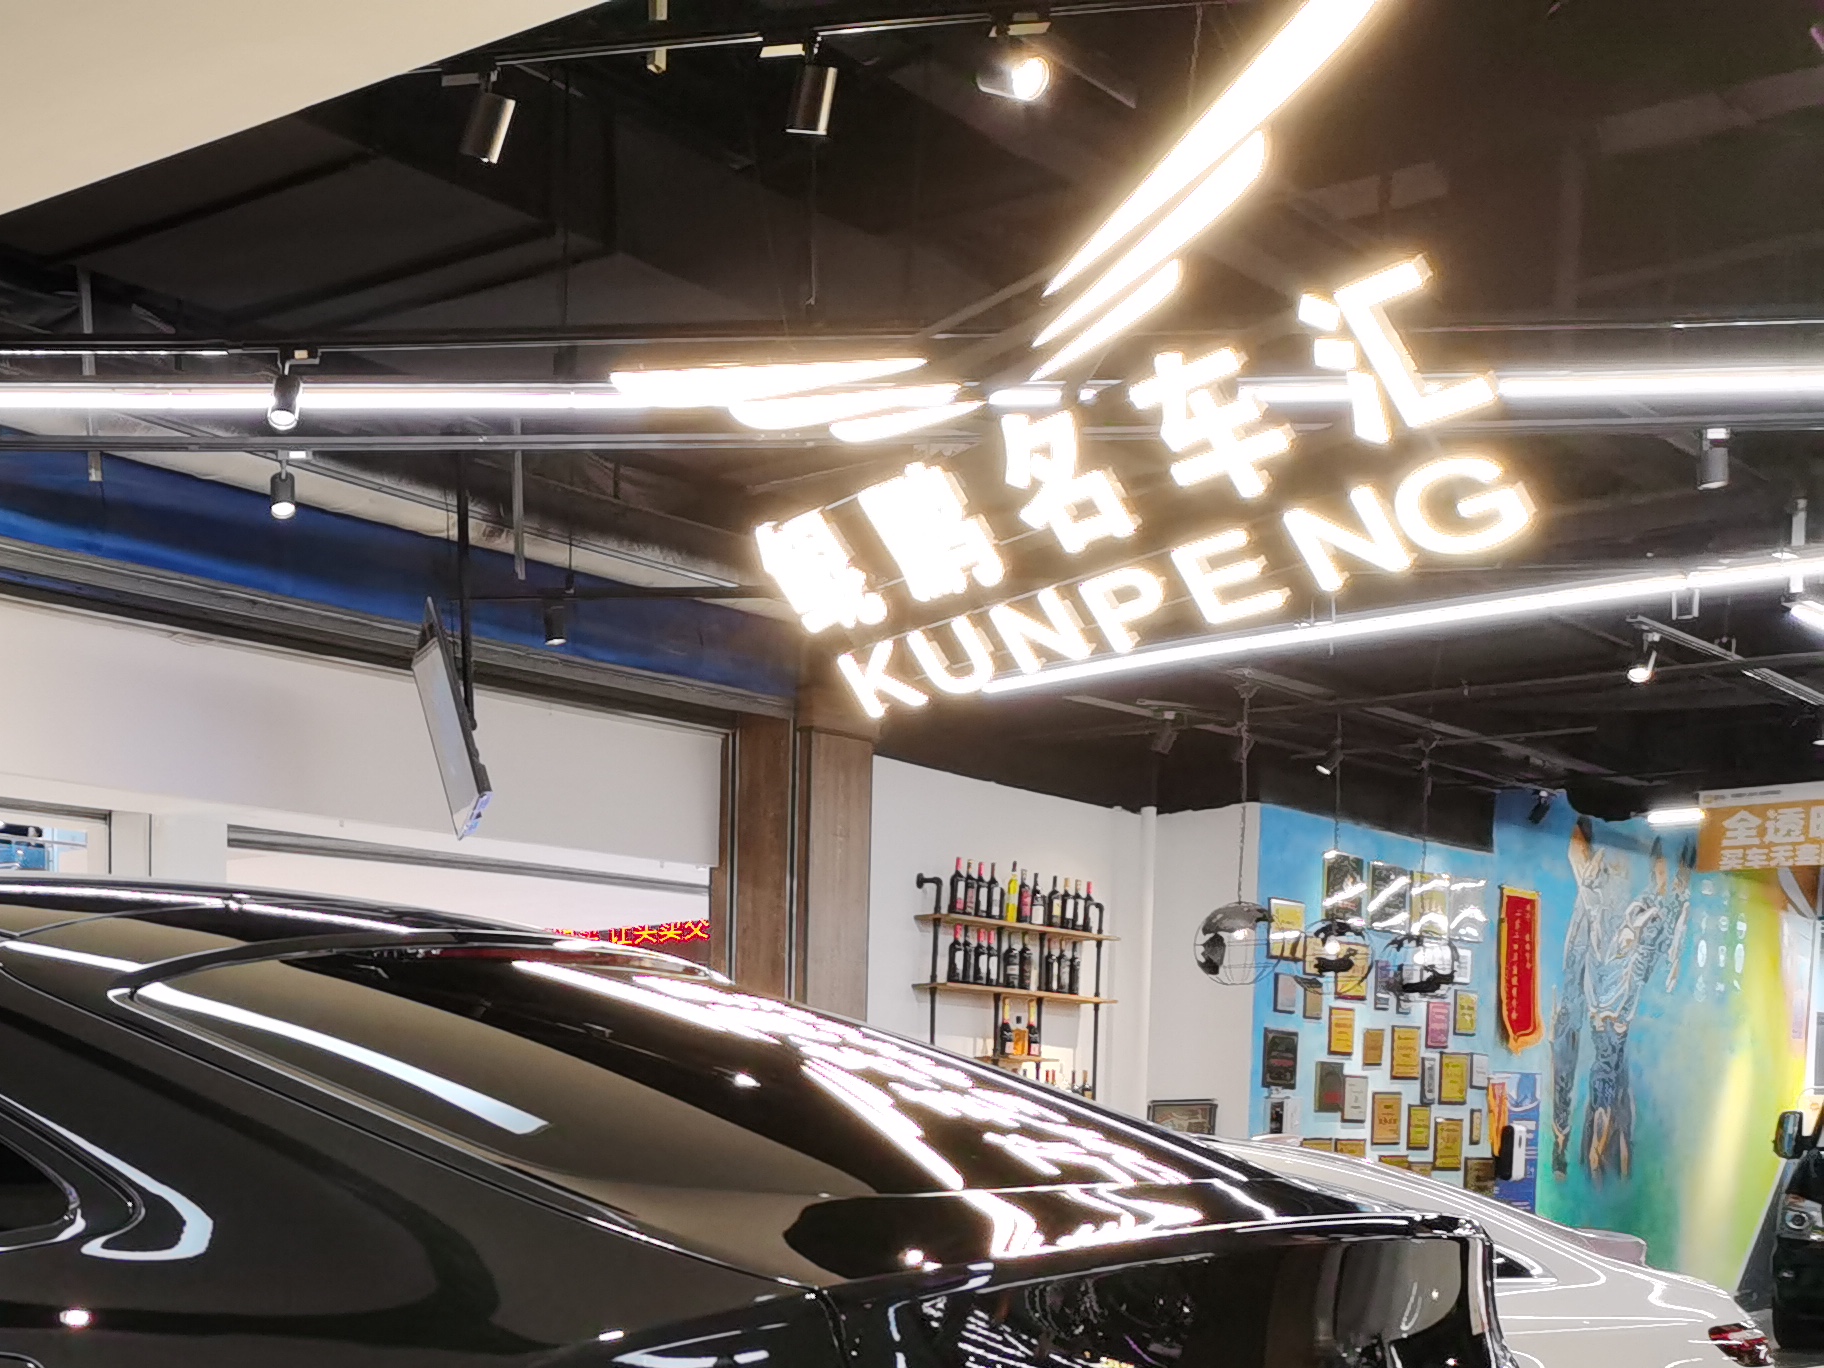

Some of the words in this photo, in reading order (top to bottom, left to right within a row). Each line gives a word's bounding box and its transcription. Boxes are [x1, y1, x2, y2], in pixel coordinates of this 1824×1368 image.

[835, 451, 1537, 718] KUNPENG
[1719, 843, 1824, 870] 买车无套
